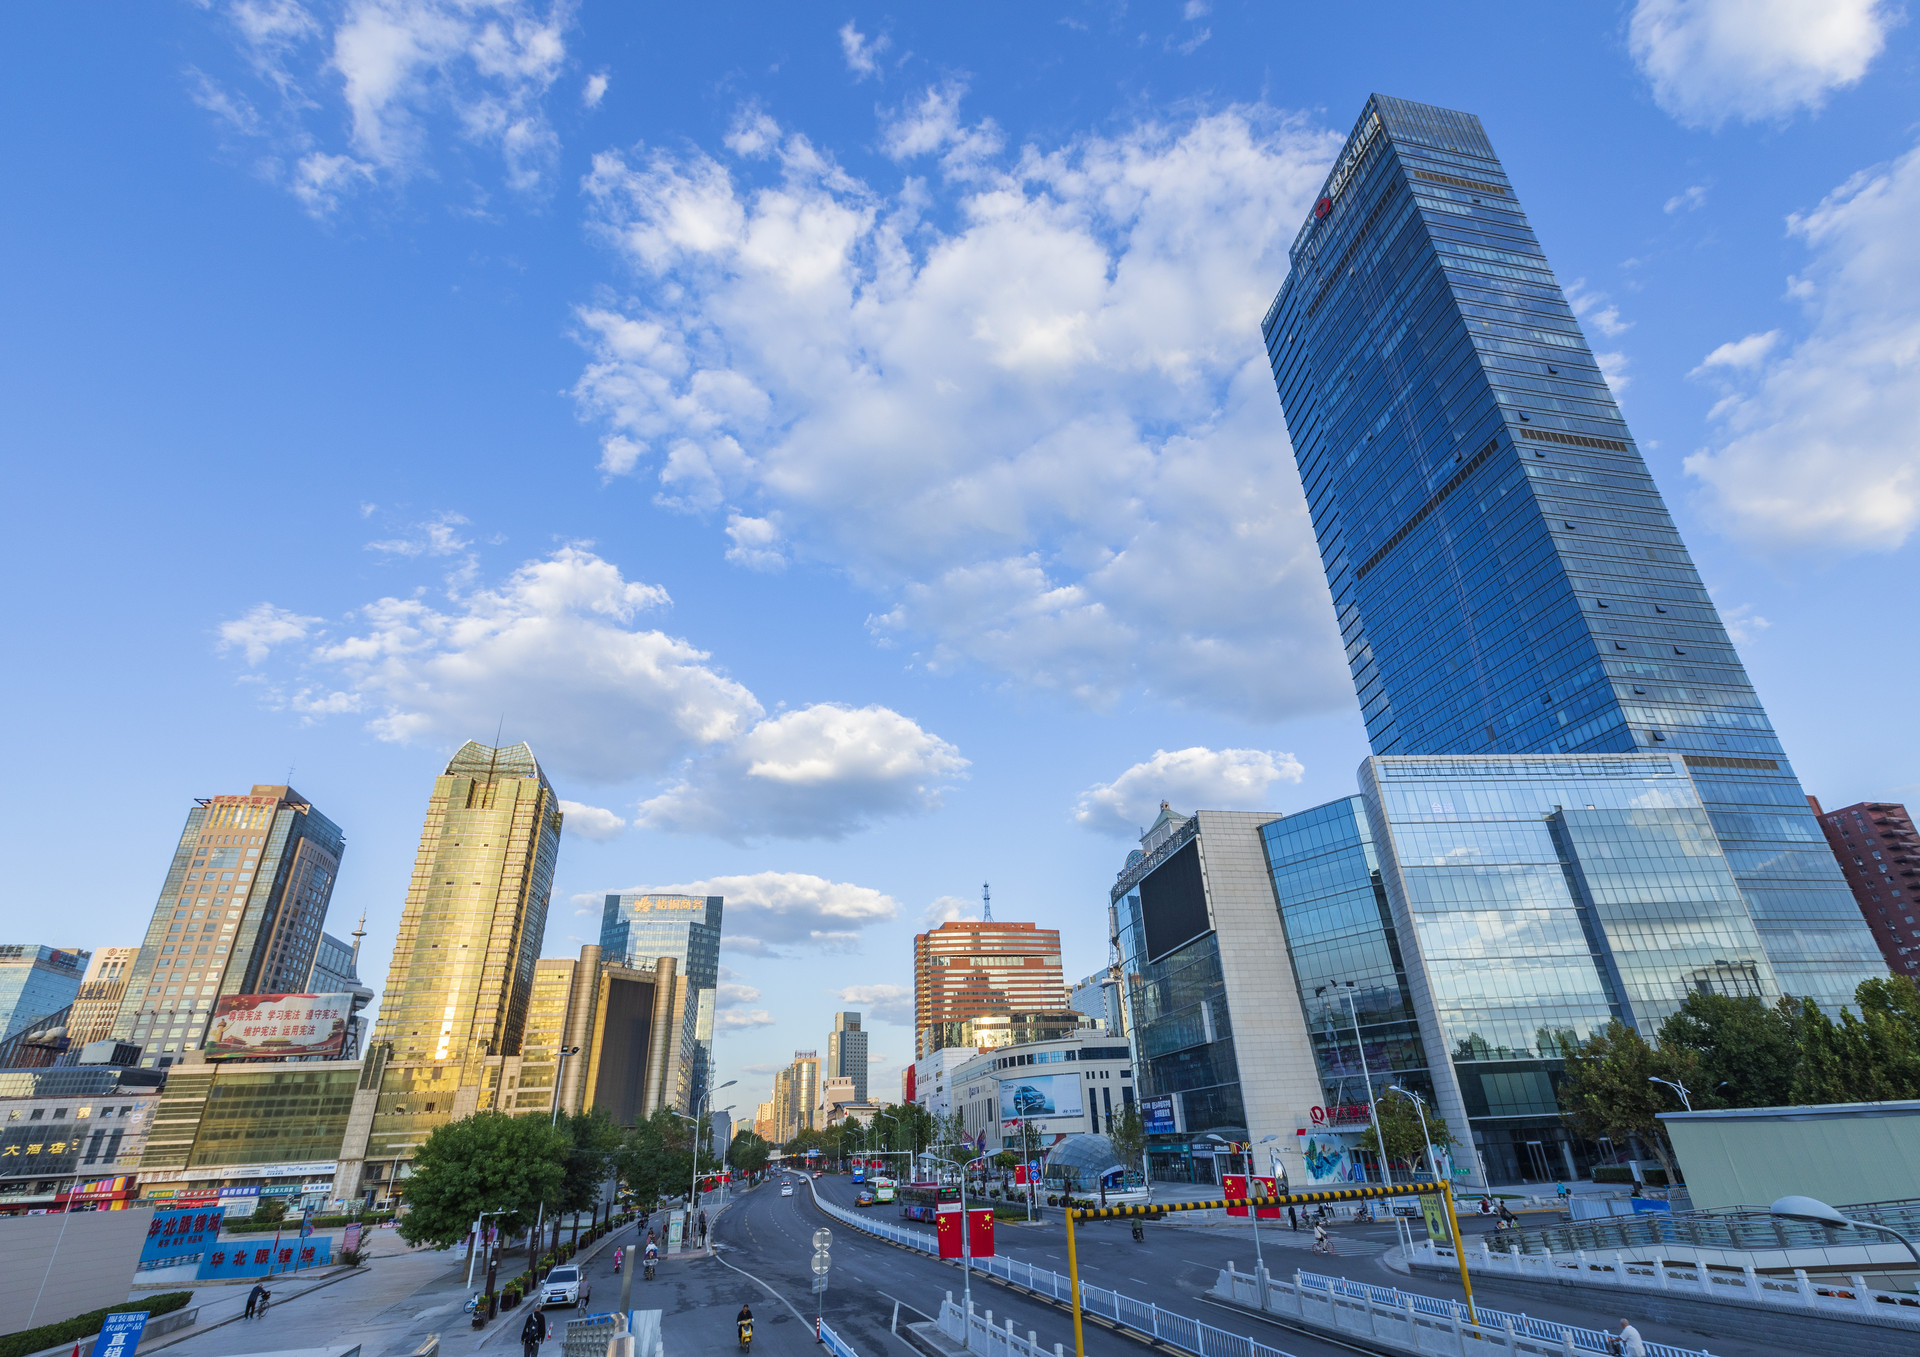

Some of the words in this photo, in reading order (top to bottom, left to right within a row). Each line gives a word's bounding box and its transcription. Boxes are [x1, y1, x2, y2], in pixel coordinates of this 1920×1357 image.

[656, 899, 703, 910] 梧桐商务
[228, 1010, 262, 1021] 尊崇宪法
[267, 1010, 301, 1020] 学习宪法
[305, 1009, 339, 1020] 遵守宪法
[243, 1026, 278, 1036] 维护宪法
[282, 1025, 316, 1036] 运用宪法
[2, 1142, 67, 1157] 大酒店
[150, 1213, 221, 1238] 华北眼镜城
[210, 1247, 316, 1267] 华北眼镜城
[107, 1314, 146, 1323] 服装服饰
[105, 1323, 142, 1332] 农副产品
[103, 1332, 129, 1357] 直销
